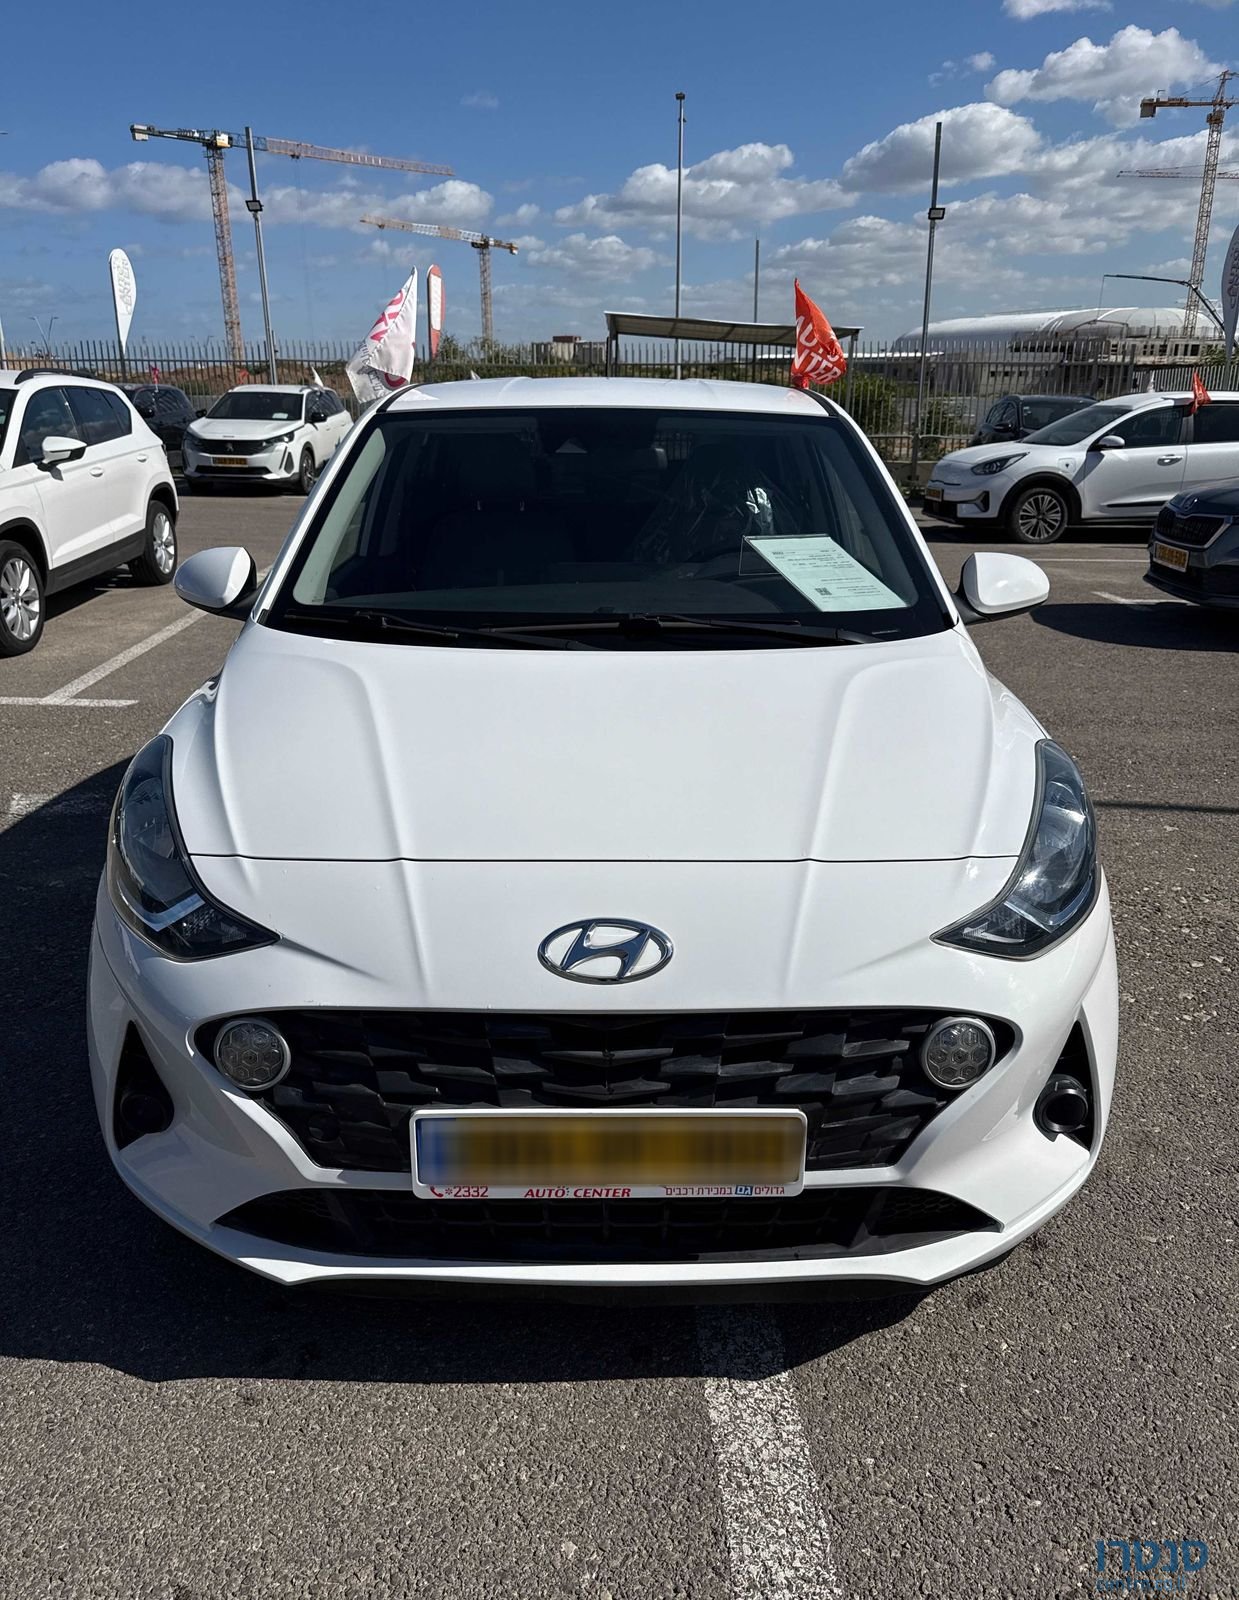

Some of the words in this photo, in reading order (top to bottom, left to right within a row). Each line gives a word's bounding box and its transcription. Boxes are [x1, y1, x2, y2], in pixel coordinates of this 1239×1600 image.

[794, 349, 841, 383] NTER
[574, 1187, 631, 1198] CENTER
[665, 1187, 694, 1196] רכבים
[697, 1187, 732, 1196] במכירת
[736, 1186, 753, 1196] גם
[754, 1186, 785, 1195] גדולים
